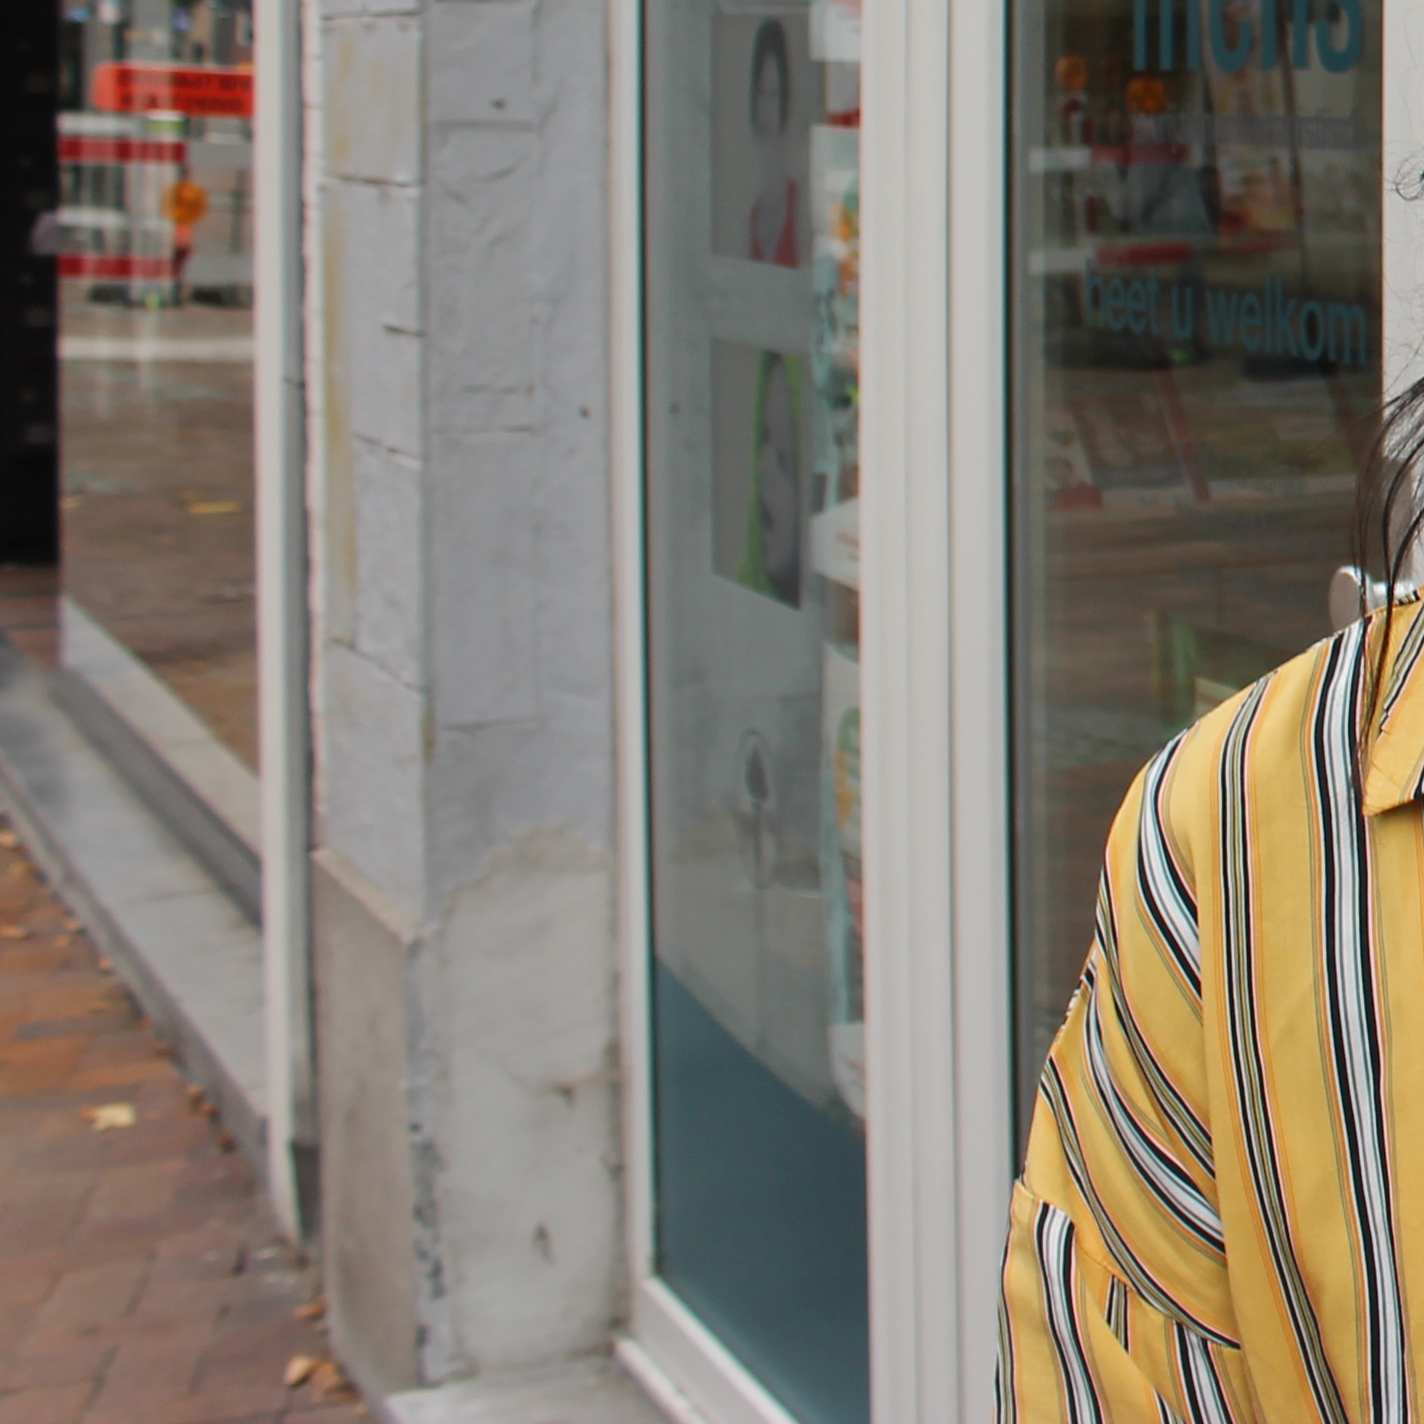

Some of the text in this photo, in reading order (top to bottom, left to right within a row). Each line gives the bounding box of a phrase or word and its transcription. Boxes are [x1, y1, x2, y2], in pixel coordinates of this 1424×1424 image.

[1084, 258, 1369, 366] heet u welkom
